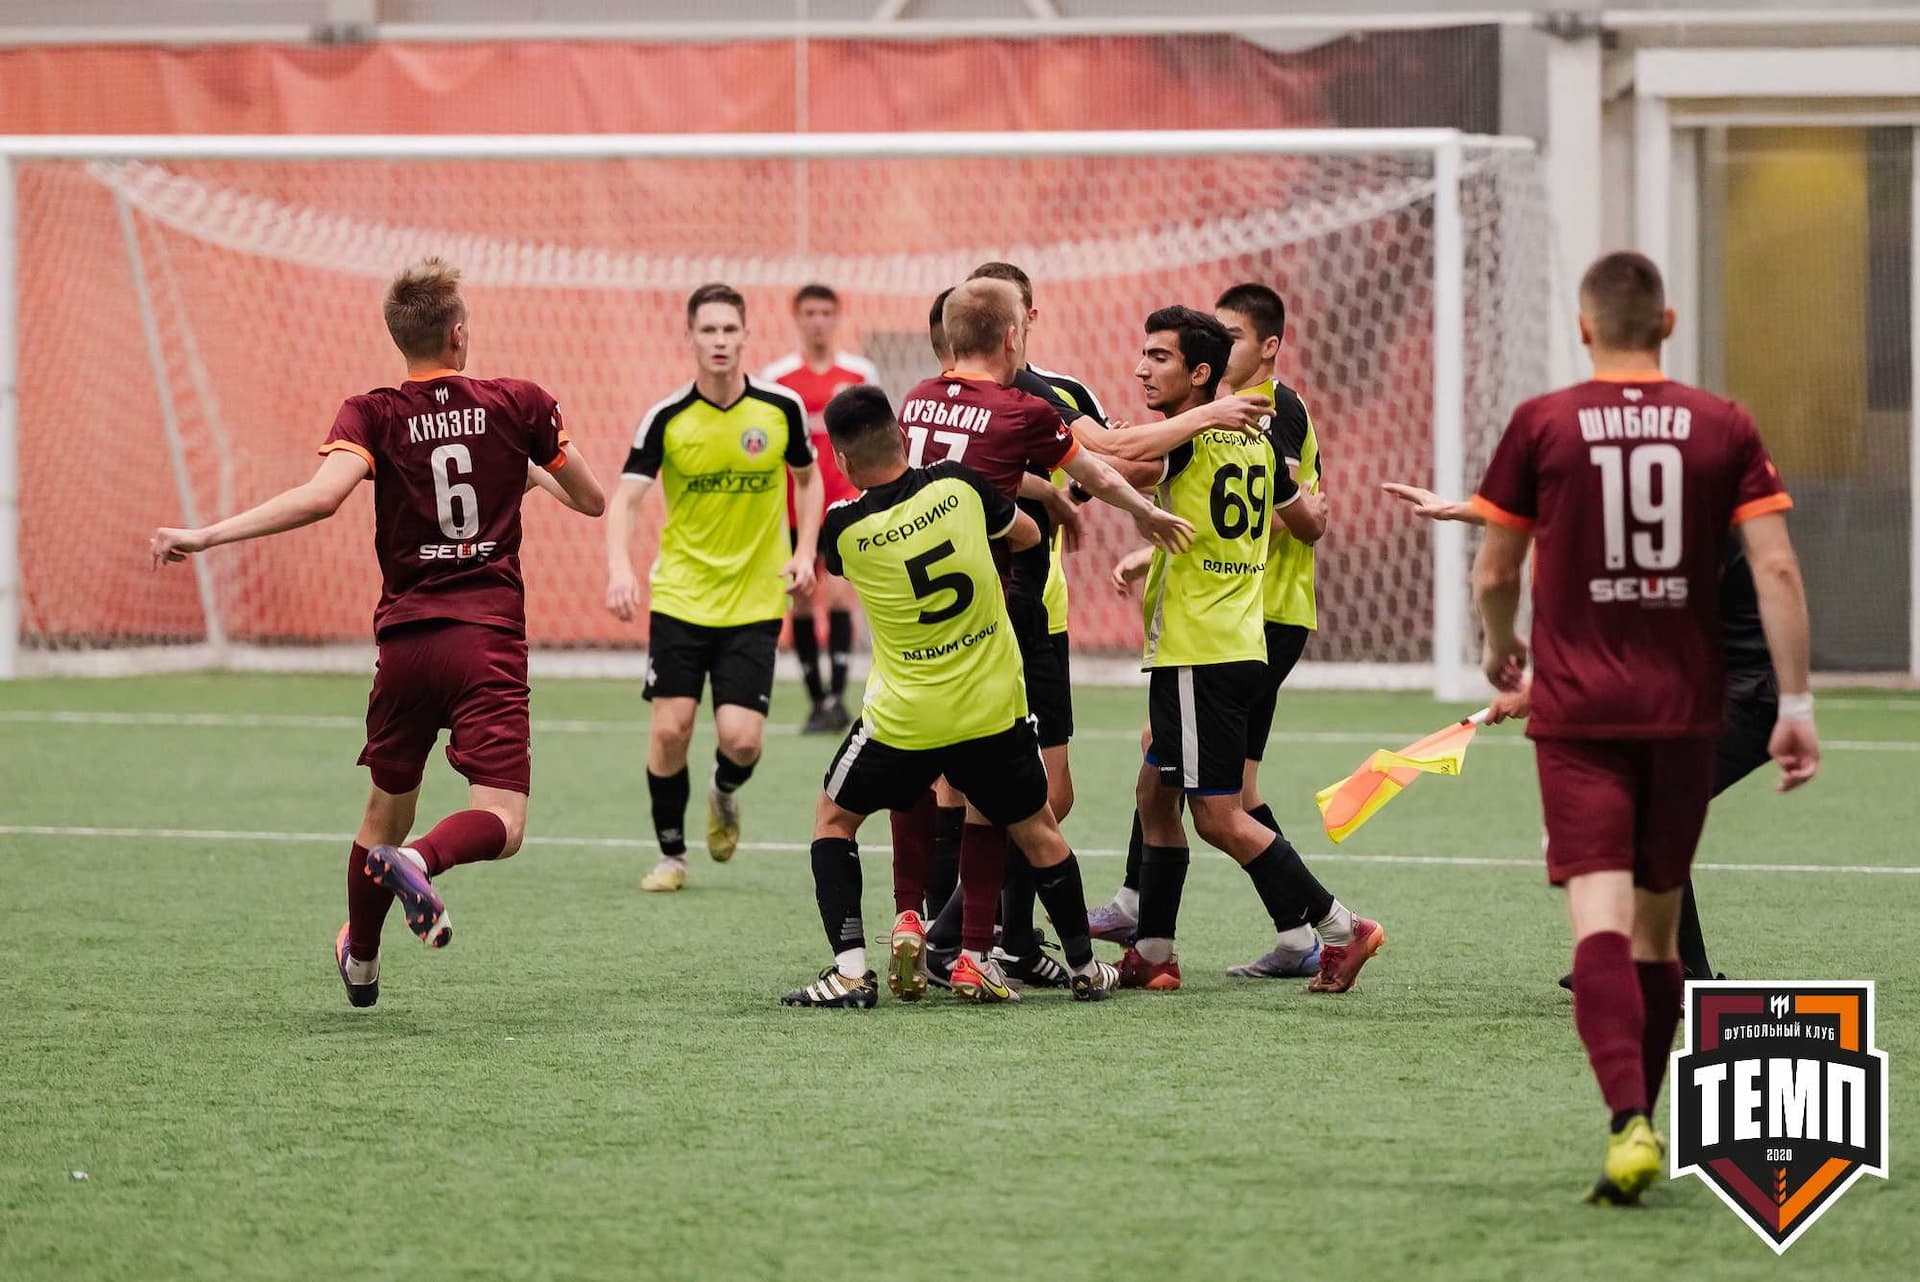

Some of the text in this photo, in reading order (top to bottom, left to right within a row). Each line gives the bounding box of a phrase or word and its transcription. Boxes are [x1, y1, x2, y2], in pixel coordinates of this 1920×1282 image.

[407, 407, 486, 444] КНЯЗЕВ
[903, 399, 992, 434] КУЗЬКИН
[1578, 405, 1692, 442] ШИБАЕВ
[907, 426, 970, 469] 17
[431, 443, 480, 540] 6
[1210, 463, 1266, 540] 69
[1590, 443, 1684, 570] 19
[419, 541, 497, 560] SEUS
[904, 538, 975, 625] 5
[1589, 577, 1688, 602] SEUS
[926, 641, 959, 661] RVM
